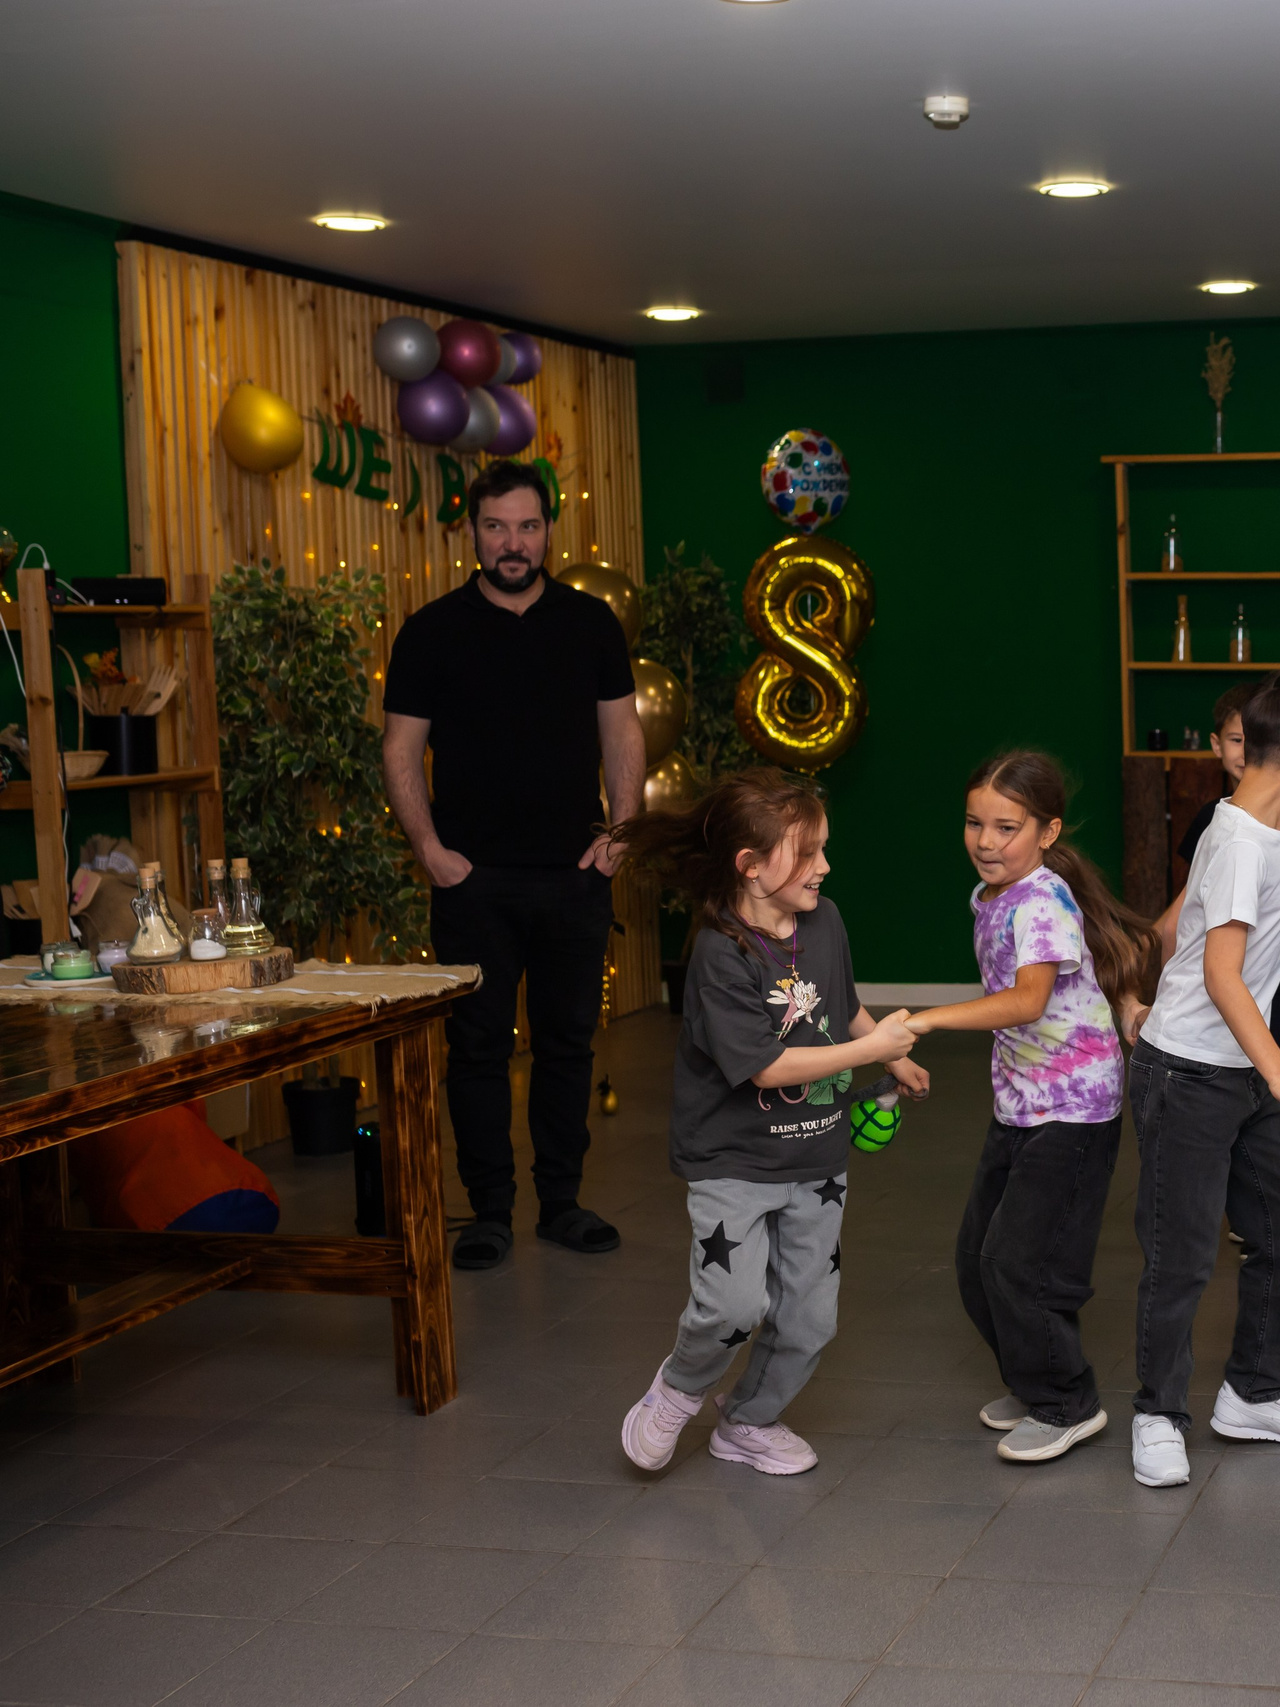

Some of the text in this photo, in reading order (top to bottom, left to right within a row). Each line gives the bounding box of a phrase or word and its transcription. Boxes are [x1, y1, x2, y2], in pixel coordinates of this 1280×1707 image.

[734, 534, 876, 776] 8
[770, 1124, 799, 1133] RAISE
[800, 1120, 819, 1131] YOU
